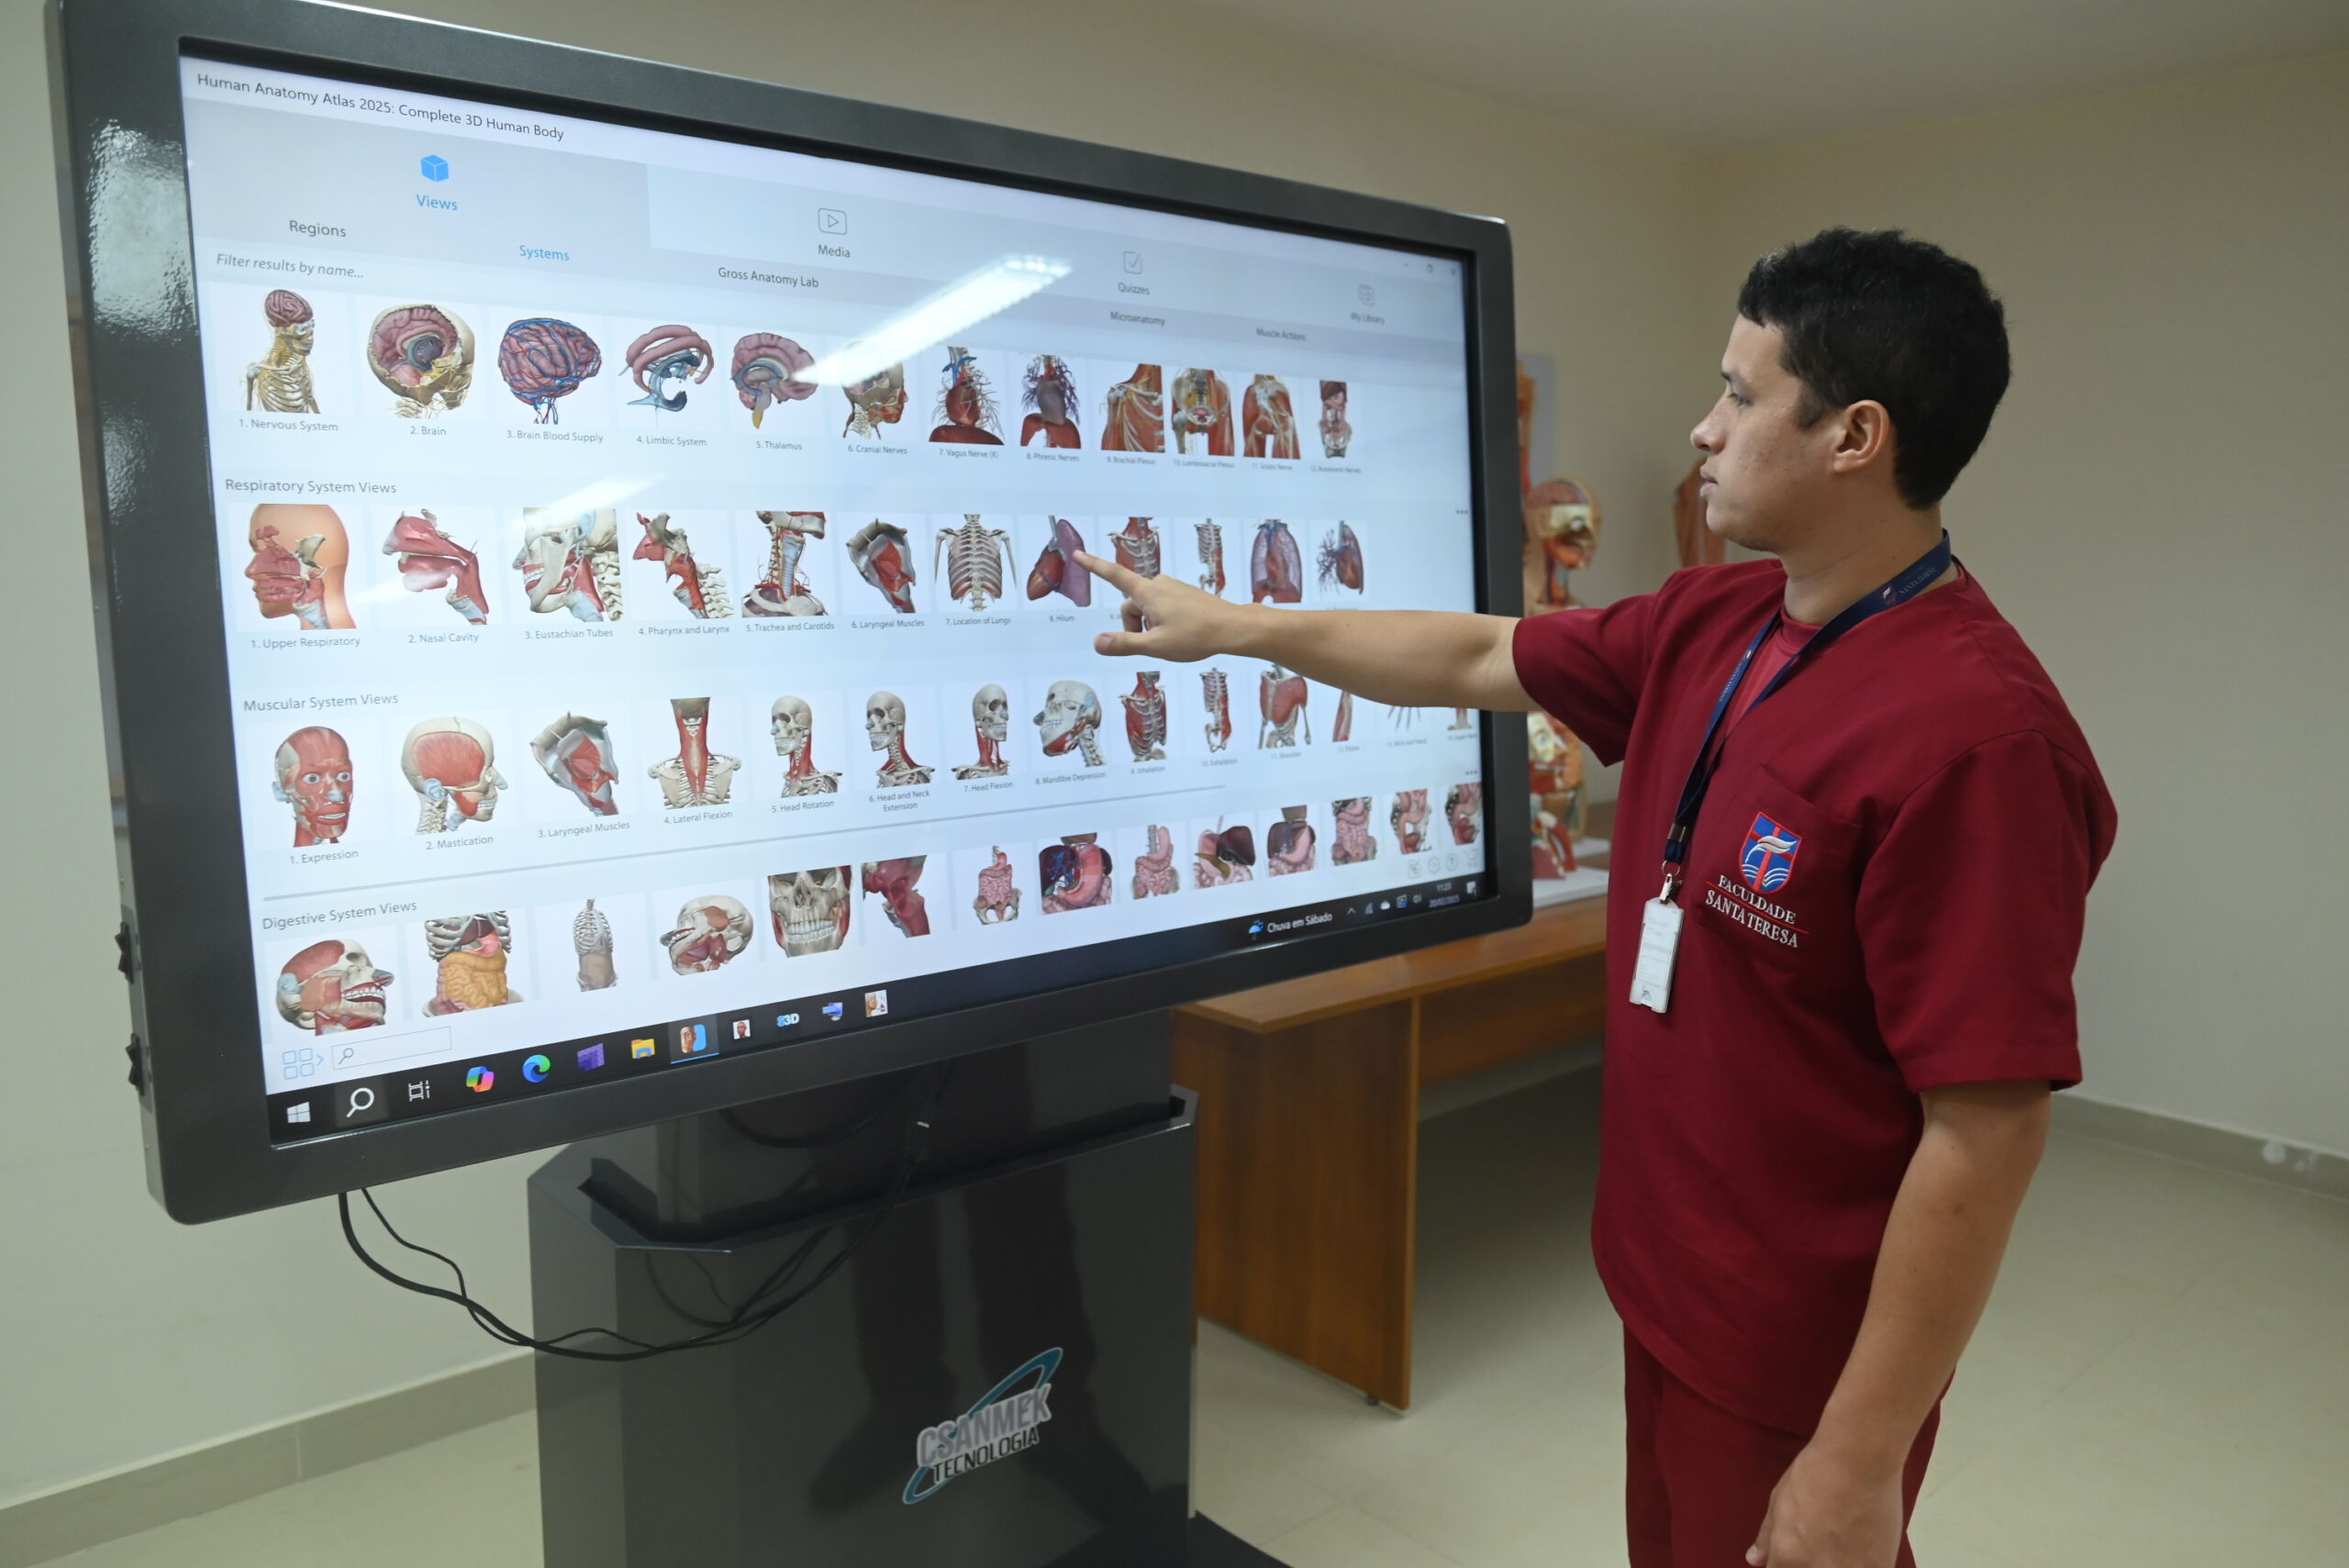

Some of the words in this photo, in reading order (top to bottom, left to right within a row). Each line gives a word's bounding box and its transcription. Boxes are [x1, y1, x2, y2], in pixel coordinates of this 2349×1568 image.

[197, 73, 250, 93] Human
[254, 81, 318, 106] Anatomy
[322, 92, 356, 108] Atlas
[360, 97, 395, 114] 2025:
[398, 105, 462, 125] Complete
[465, 114, 483, 127] 3D
[486, 117, 530, 135] Human
[533, 124, 565, 142] Body
[416, 194, 458, 212] Views
[289, 219, 347, 239] Regions
[518, 244, 570, 262] Systems
[818, 243, 851, 259] Media
[216, 253, 250, 271] Filter
[252, 257, 296, 274] results
[299, 260, 314, 278] by
[317, 265, 364, 280] name...
[718, 266, 749, 282] Gross
[751, 270, 797, 288] Anatomy
[800, 274, 819, 288] Lab
[1118, 282, 1150, 296] Quizzes
[1109, 311, 1165, 328] Microanatomy
[239, 419, 249, 428] 1.
[250, 419, 297, 430] Nervous
[300, 421, 339, 433] System
[410, 426, 418, 435] 2.
[421, 426, 447, 436] Brain
[507, 429, 515, 439] 3.
[518, 430, 540, 440] Brain
[543, 431, 570, 441] Blood
[572, 432, 603, 444] Supply
[637, 435, 645, 445] 4.
[646, 436, 674, 446] Limbic
[677, 437, 707, 448] System
[756, 440, 763, 449] 5.
[765, 440, 802, 450] Thalamus
[848, 445, 855, 453] 6.
[856, 446, 881, 454] Cranial
[883, 446, 907, 455] Nerves
[946, 449, 966, 458] Vagus
[968, 450, 988, 458] Nerve
[225, 479, 304, 495] Respiratory
[307, 480, 355, 495] System
[358, 482, 396, 495] Views
[746, 624, 753, 632] 5.
[755, 623, 785, 631] Trachea
[786, 622, 802, 630] and
[804, 621, 835, 630] Carotids
[852, 620, 859, 628] 6.
[860, 619, 896, 630] Laryngeal
[896, 618, 925, 628] Muscles
[953, 617, 982, 626] Location
[991, 617, 1011, 626] Lungs
[408, 634, 417, 643] 2.
[419, 634, 446, 643] Nasal
[449, 633, 479, 644] Cavity
[526, 630, 534, 639] 3.
[536, 629, 584, 639] Eustachian
[587, 628, 614, 638] Tubes
[639, 628, 647, 636] 4.
[649, 626, 683, 638] Pharynx
[685, 626, 701, 635] and
[703, 624, 729, 636] Larynx
[251, 639, 261, 649] 1.
[262, 639, 297, 651] Upper
[300, 637, 361, 649] Respiratory
[243, 697, 306, 712] Muscular
[309, 695, 357, 711] System
[361, 694, 398, 706] Views
[972, 784, 988, 792] Head
[877, 793, 896, 802] Head
[898, 791, 910, 800] and
[912, 790, 930, 799] Neck
[772, 806, 779, 814] 5.
[781, 803, 800, 812] Head
[802, 799, 834, 809] Rotation
[883, 801, 918, 812] Extension
[663, 816, 672, 825] 4.
[674, 813, 701, 824] Lateral
[703, 810, 732, 820] Flexion
[539, 829, 546, 839] 3.
[549, 825, 593, 839] Laryngeal
[596, 820, 630, 832] Muscles
[427, 841, 435, 851] 2.
[437, 835, 494, 850] Mastication
[290, 854, 299, 864] 1.
[301, 850, 359, 865] Expression
[1718, 875, 1797, 926] FACULDADE
[262, 911, 327, 930] Digestive
[329, 906, 376, 922] System
[379, 901, 417, 915] Views
[1267, 920, 1292, 934] Chuva
[1292, 918, 1305, 929] em
[1306, 911, 1333, 927] Sábado
[1706, 889, 1745, 925] SANTA
[1747, 912, 1798, 949] TERESA
[918, 1384, 1052, 1468] CSANMEK
[933, 1426, 1039, 1484] TECNOLOGIA
